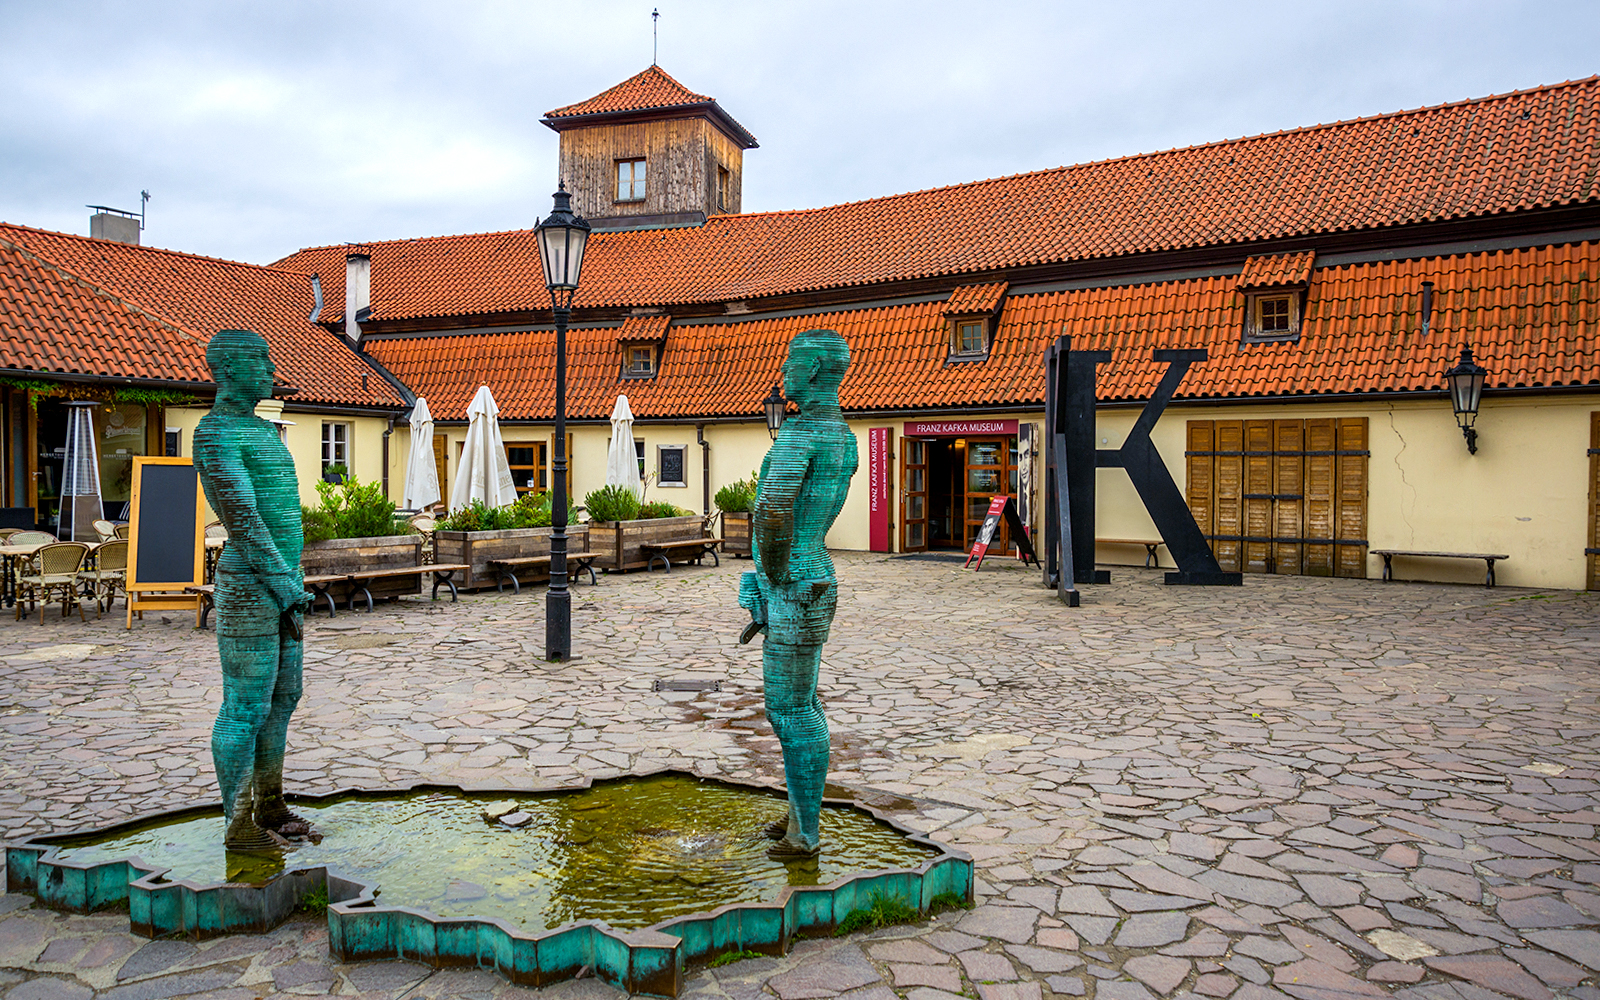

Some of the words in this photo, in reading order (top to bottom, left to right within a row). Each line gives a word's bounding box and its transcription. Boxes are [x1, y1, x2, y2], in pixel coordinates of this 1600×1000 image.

[916, 424, 941, 433] FRANZ
[942, 423, 968, 433] KAFKA
[969, 422, 1004, 432] MUSEUM
